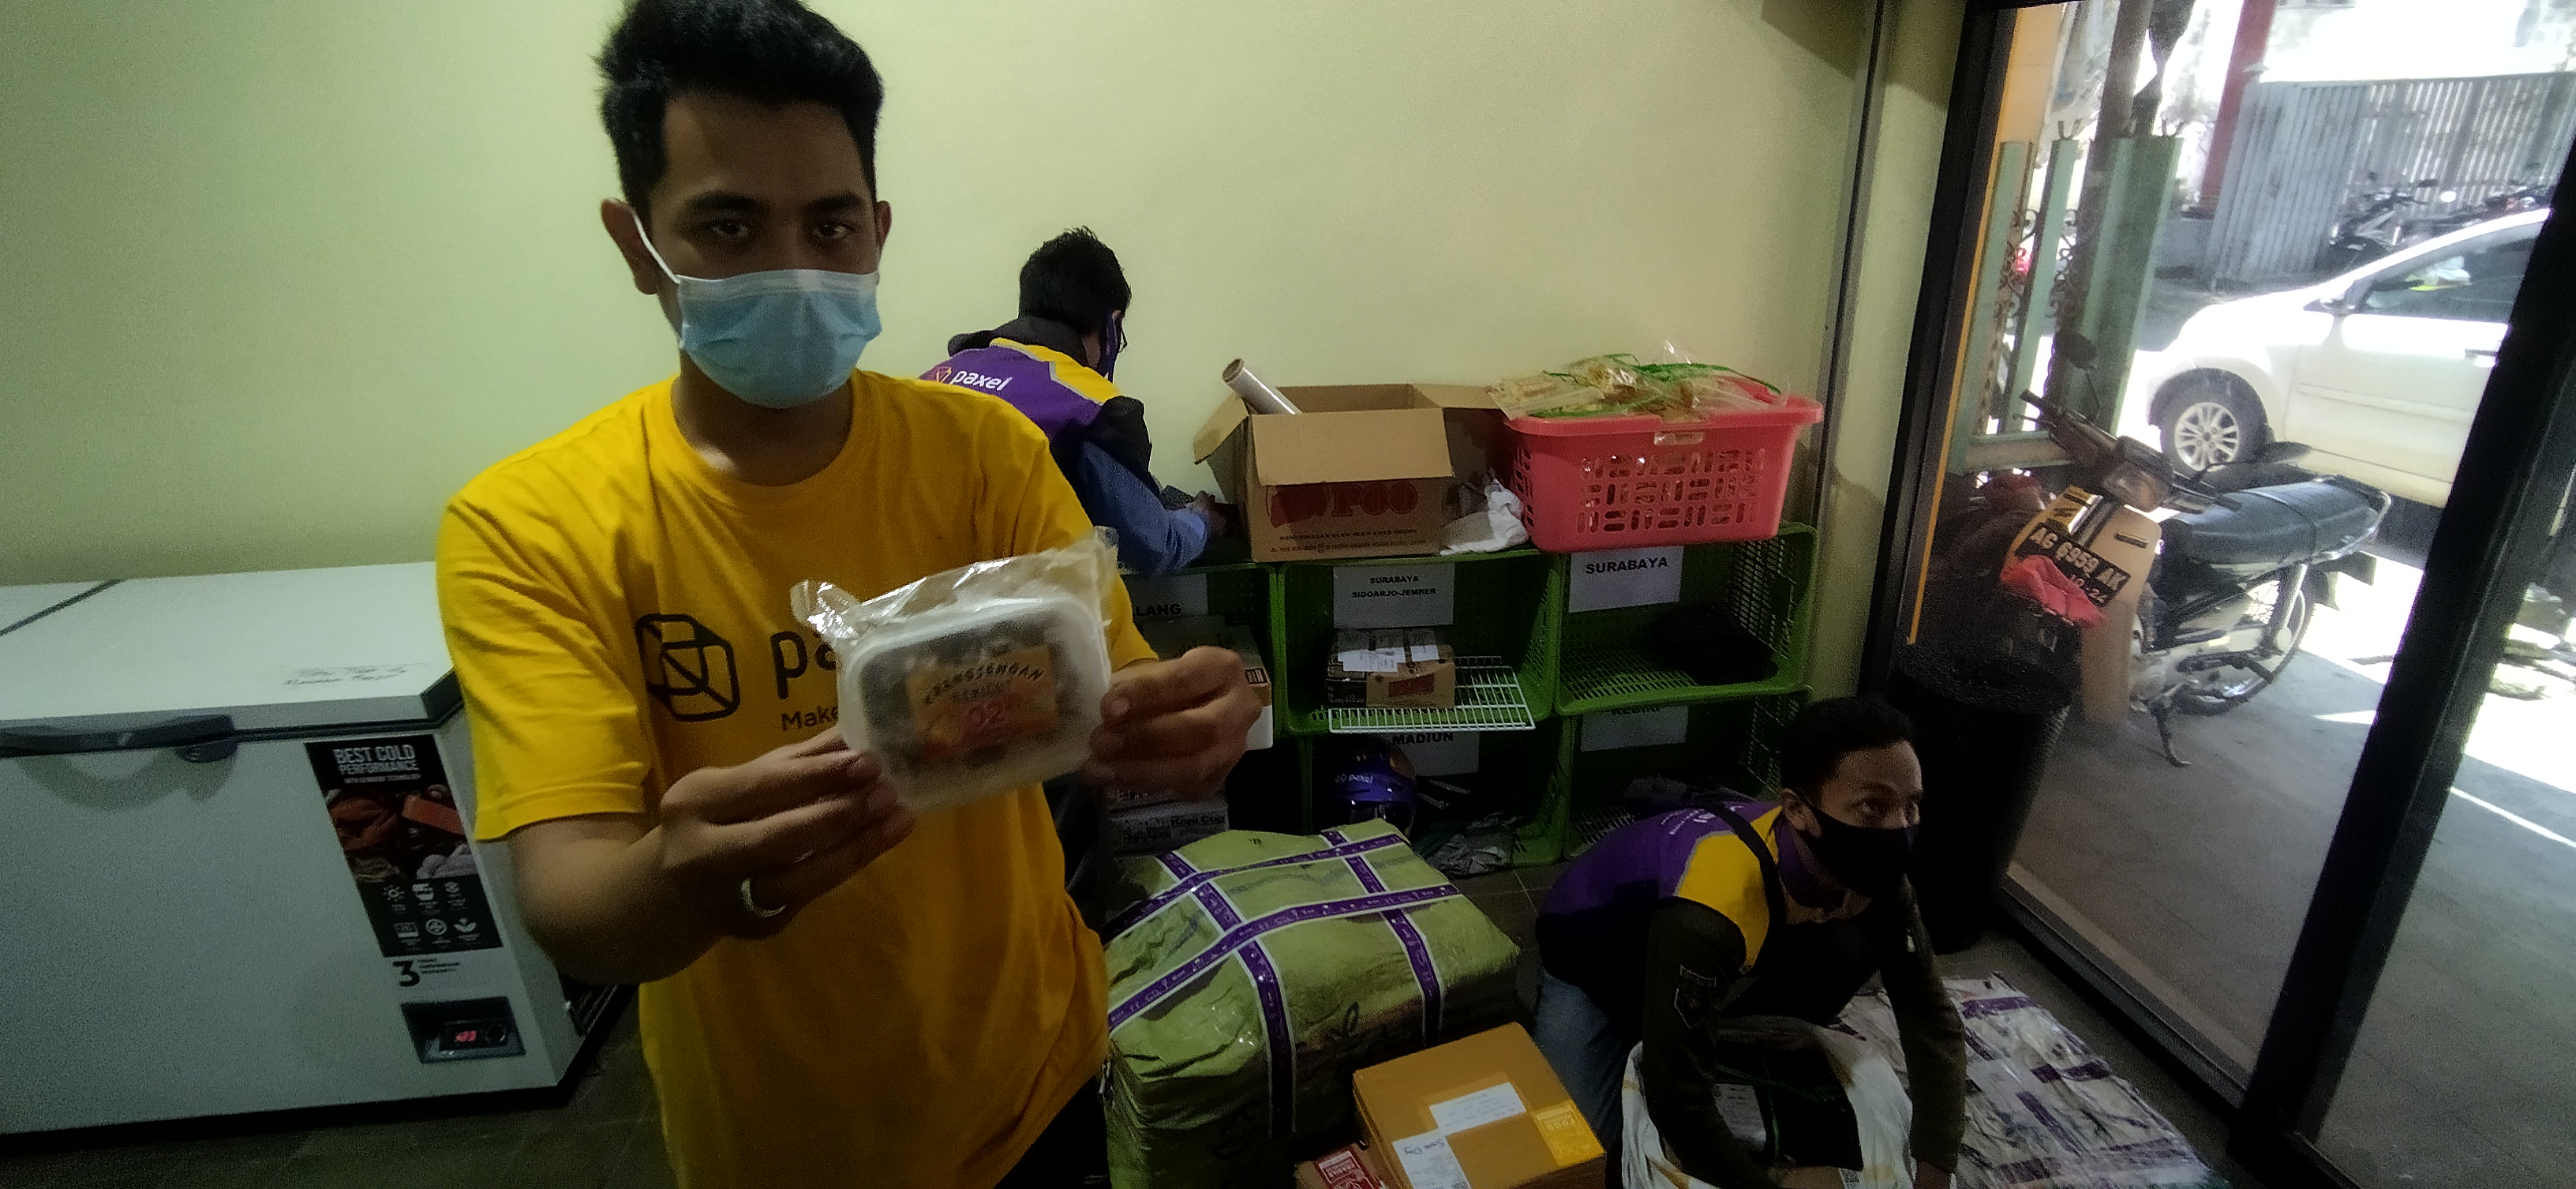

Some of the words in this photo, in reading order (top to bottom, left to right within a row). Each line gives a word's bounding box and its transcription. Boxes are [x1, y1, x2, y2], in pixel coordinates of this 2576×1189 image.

[949, 369, 1013, 391] paxel
[1586, 557, 1669, 574] SURABAYA
[2029, 527, 2058, 549] AG
[2057, 541, 2099, 574] 6959
[2095, 567, 2127, 591] AK
[1369, 576, 1419, 584] SURABAYA
[1135, 603, 1181, 617] LANG
[1391, 733, 1454, 745] MADIUN
[332, 747, 373, 764] BEST
[375, 745, 416, 761] COLD
[338, 760, 421, 775] PERFORMANCE
[392, 960, 421, 987] 3
